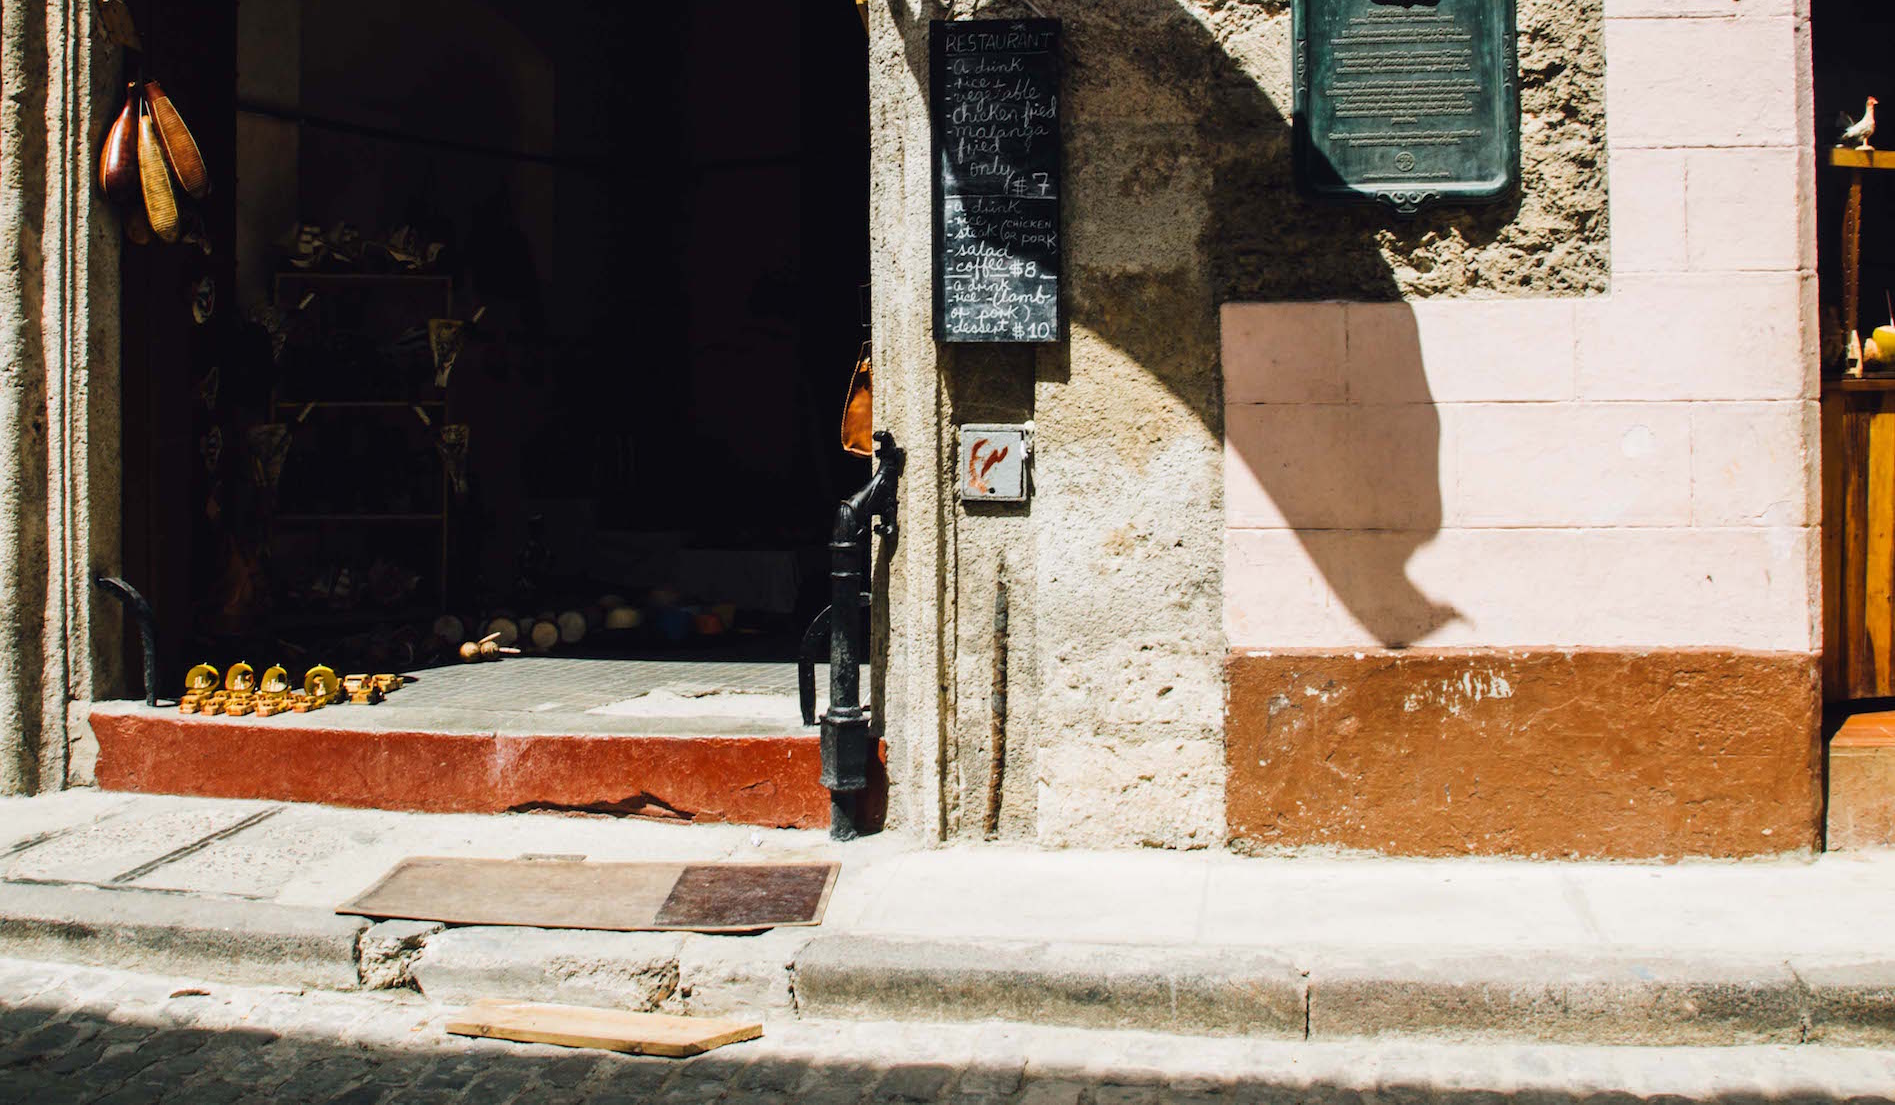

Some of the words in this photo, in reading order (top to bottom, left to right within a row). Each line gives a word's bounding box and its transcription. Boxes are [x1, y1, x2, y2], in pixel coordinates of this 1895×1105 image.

[945, 32, 1054, 53] RESTAURANT
[954, 76, 991, 89] rice
[954, 79, 1040, 112] vegetable
[1021, 95, 1057, 127] fried
[953, 124, 1048, 152] malanga
[955, 137, 1000, 165] fried
[953, 199, 965, 213] a
[954, 213, 986, 226] rice
[955, 240, 1014, 257] salad
[956, 257, 1008, 280] coffee
[954, 281, 964, 292] a
[953, 291, 980, 303] rice
[952, 320, 1009, 334] dessert
[1012, 322, 1050, 340] $10
